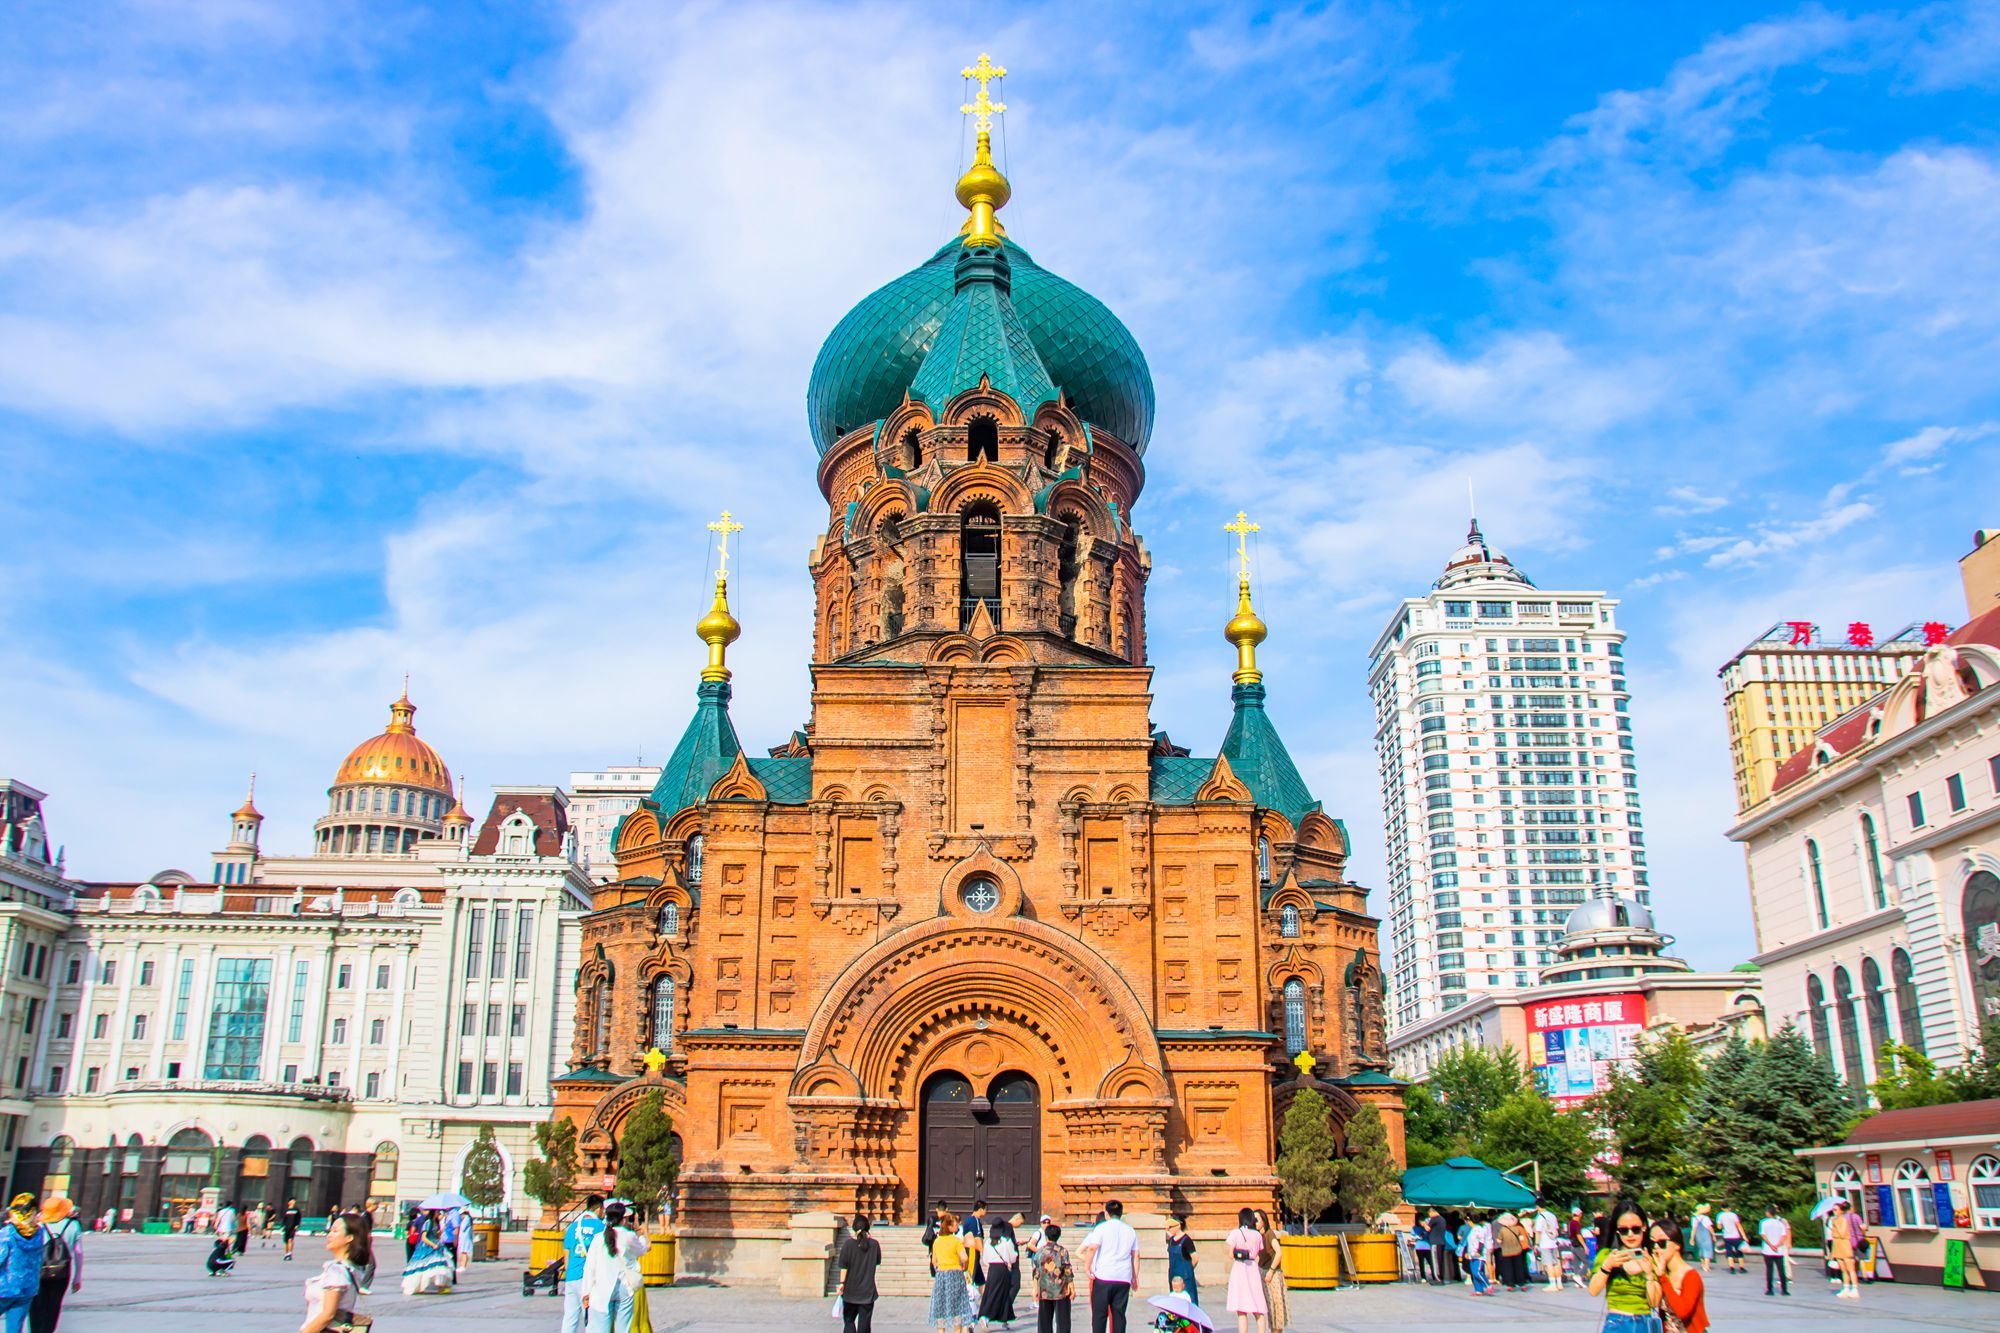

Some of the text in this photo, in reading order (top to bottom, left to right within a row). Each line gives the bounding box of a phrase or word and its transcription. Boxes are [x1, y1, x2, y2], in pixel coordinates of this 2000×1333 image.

[1534, 1001, 1624, 1028] 新盛隆商厦
